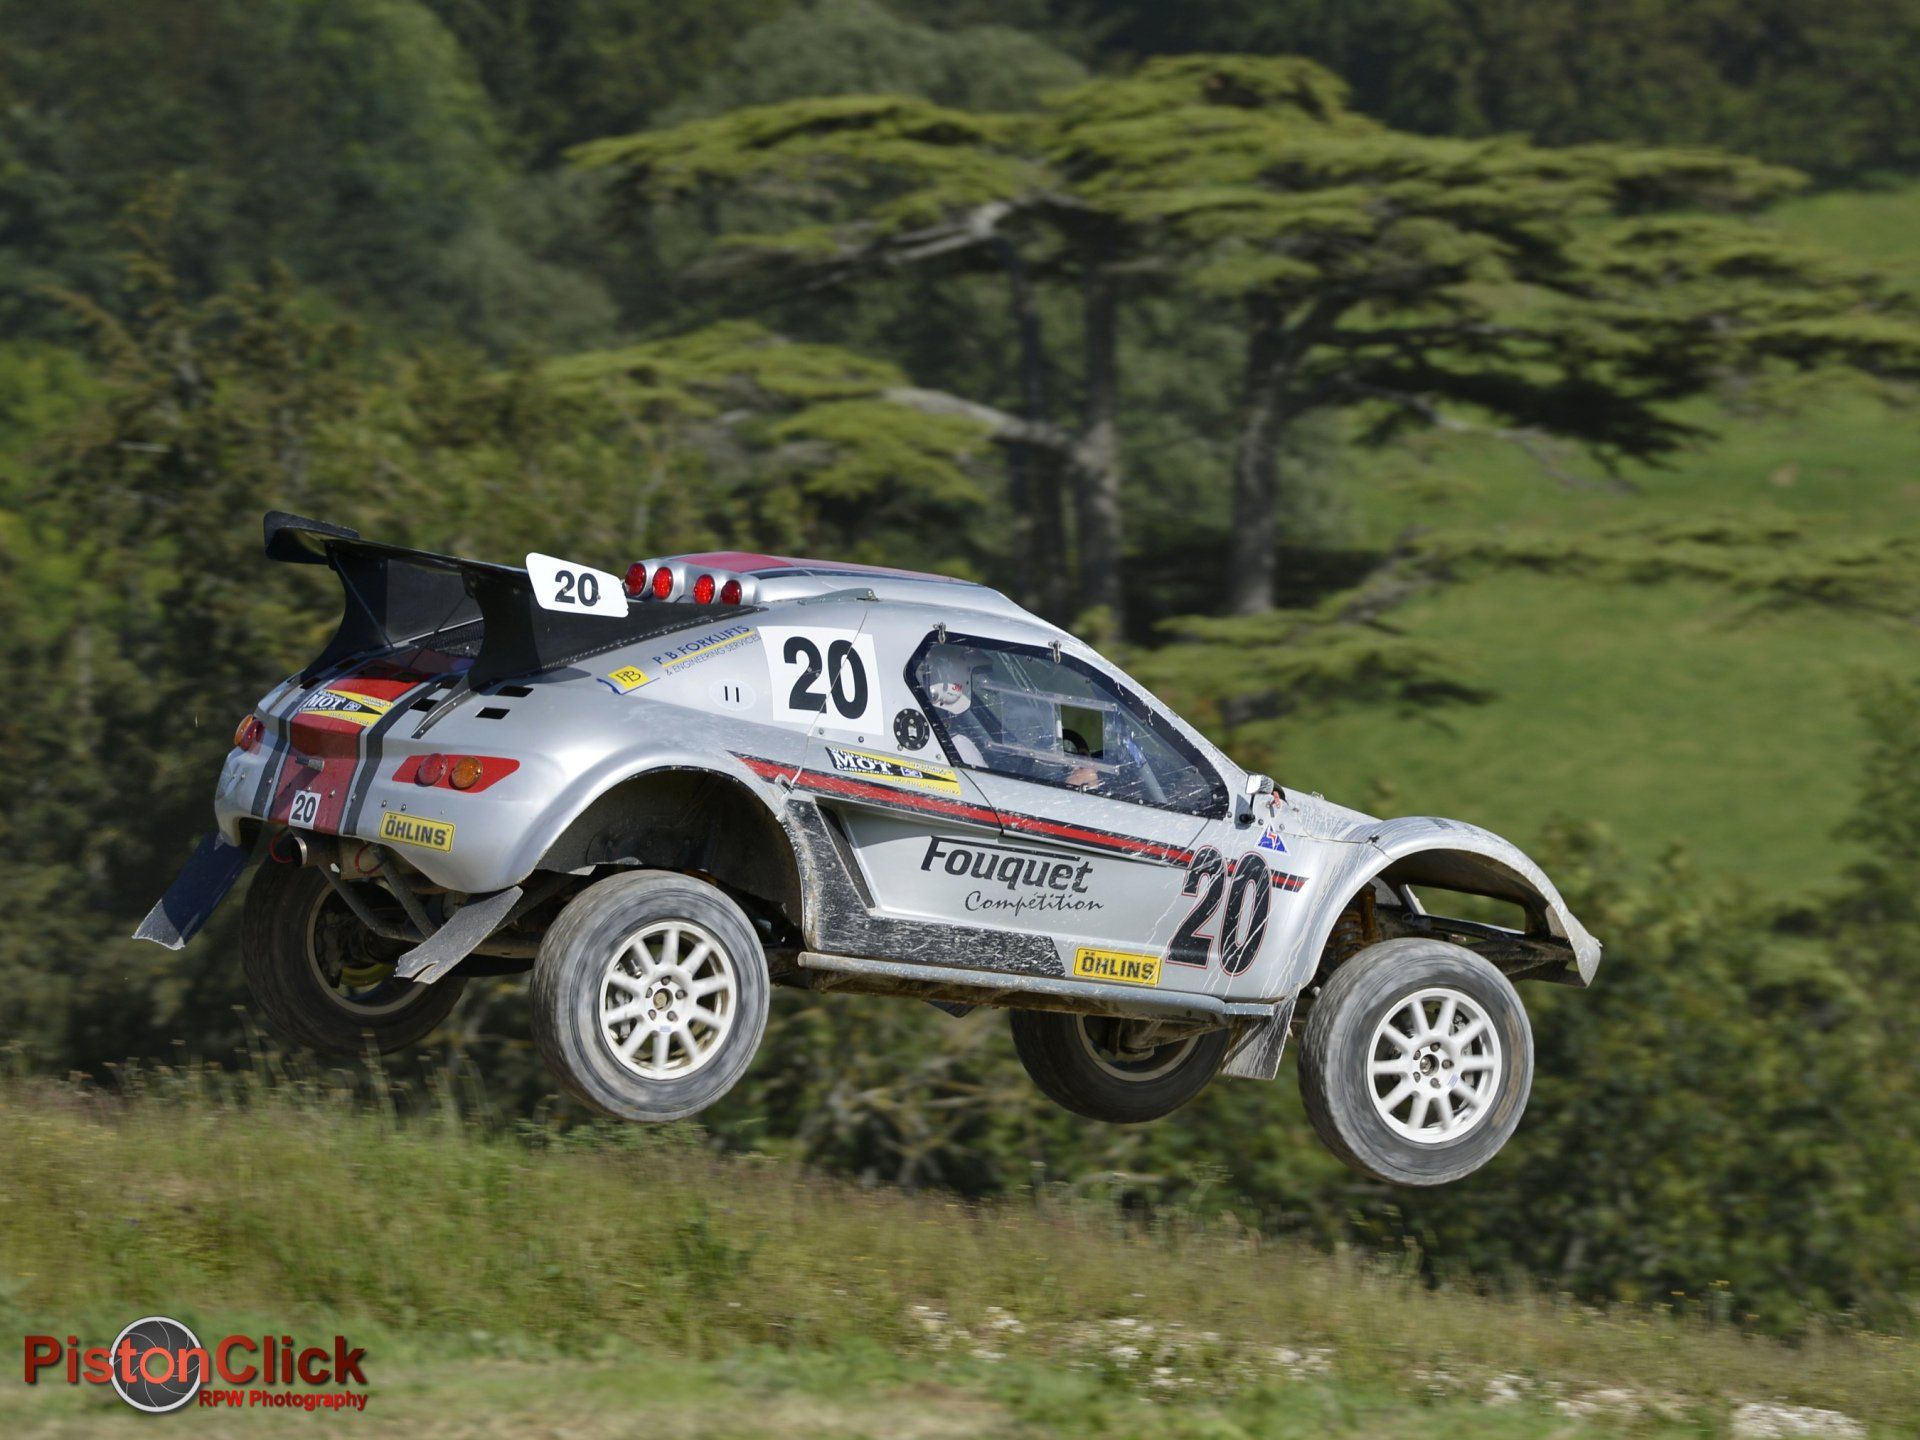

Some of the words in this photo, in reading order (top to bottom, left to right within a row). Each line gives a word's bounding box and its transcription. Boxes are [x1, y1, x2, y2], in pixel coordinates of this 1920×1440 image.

[555, 570, 599, 607] 20
[677, 625, 750, 655] FORKLIFTS
[673, 646, 726, 673] ENGINEERING
[783, 636, 868, 719] 20
[302, 694, 347, 708] MOT
[832, 751, 893, 773] MOT
[293, 795, 316, 823] 20
[385, 815, 447, 846] ÖHLINS
[920, 835, 1094, 893] Fouquet
[965, 890, 1104, 916] Compétition
[1166, 844, 1272, 977] 20
[1081, 951, 1155, 980] ÖHLINS
